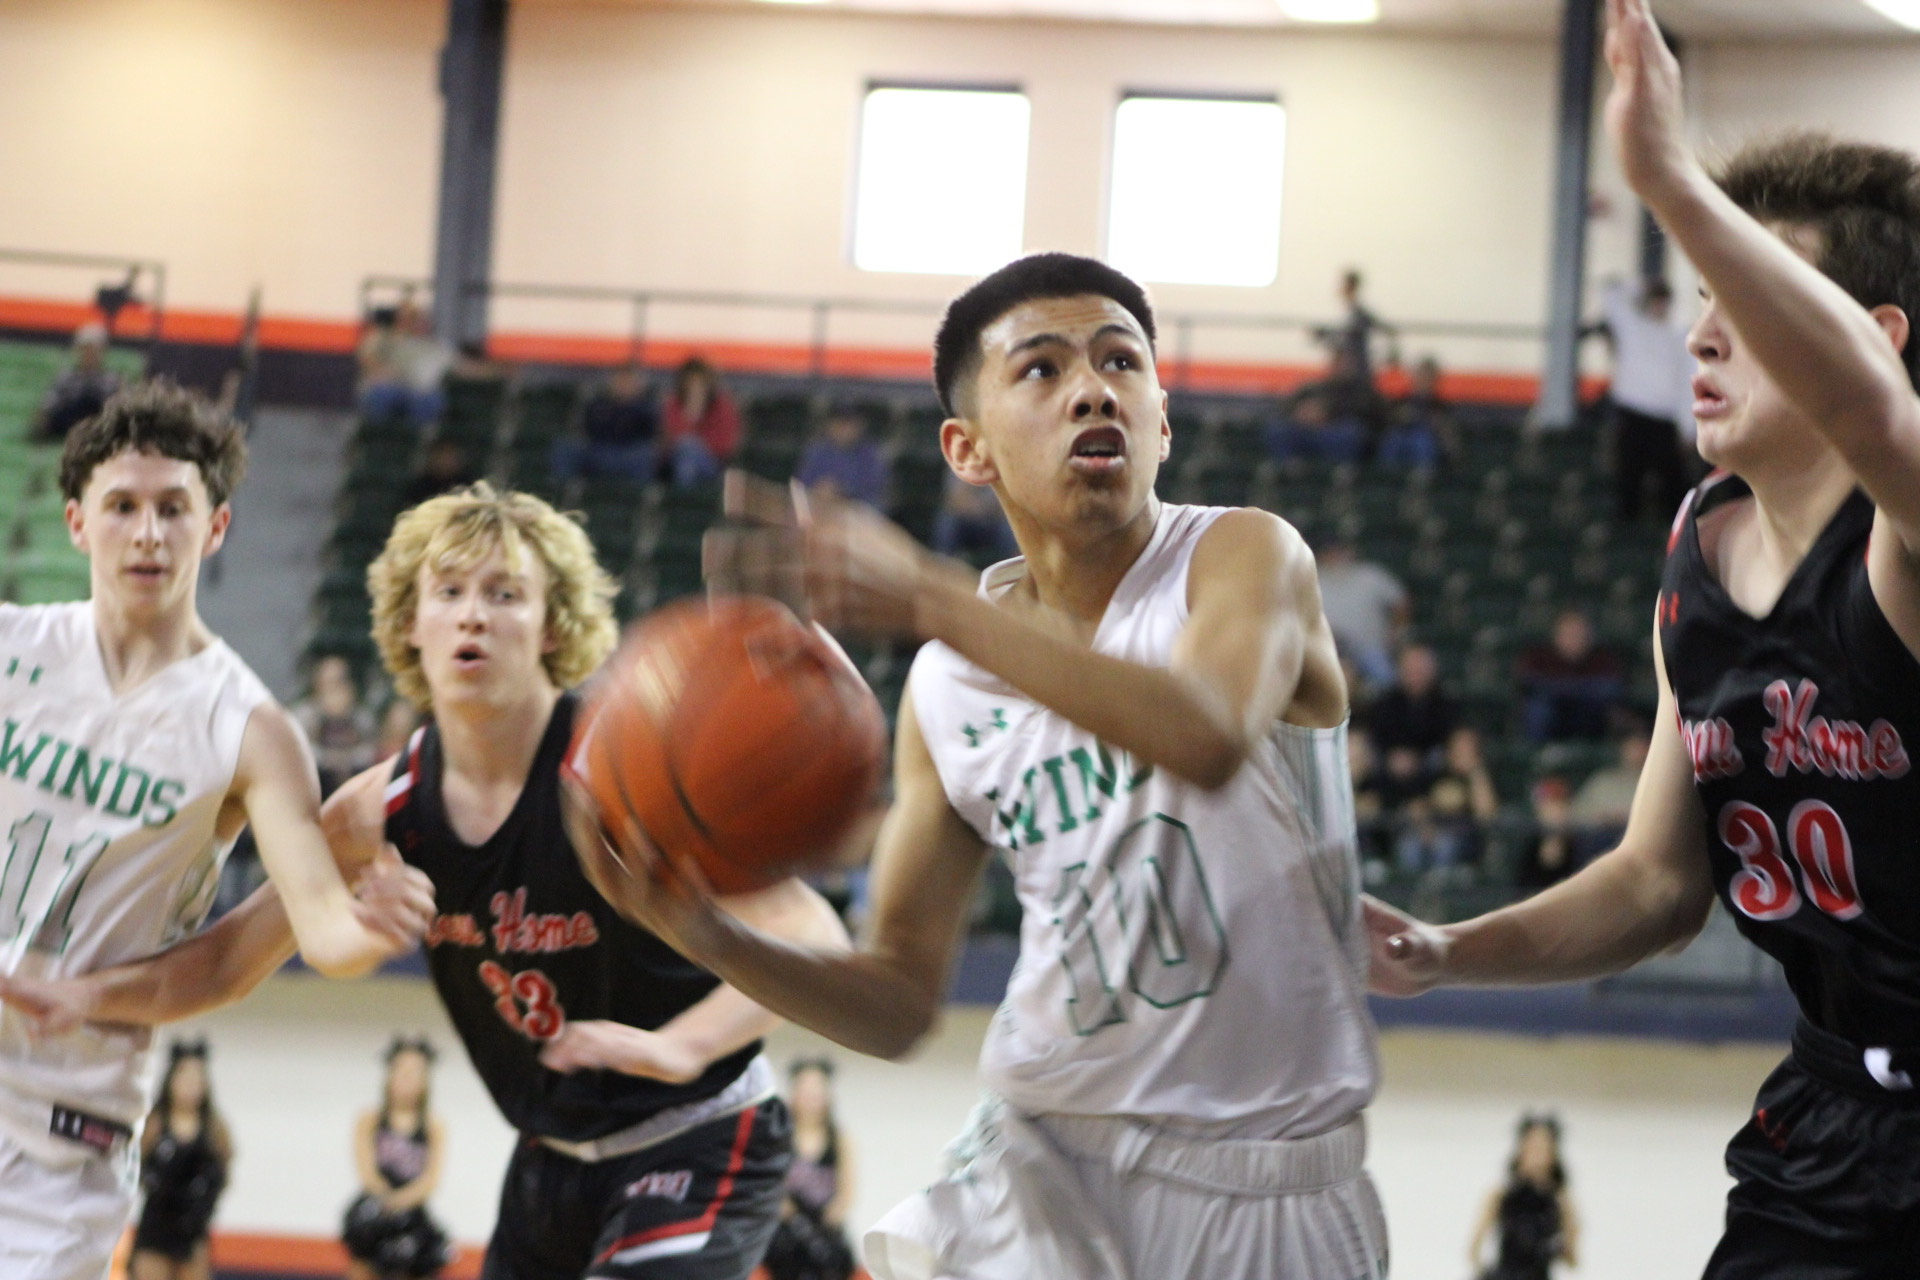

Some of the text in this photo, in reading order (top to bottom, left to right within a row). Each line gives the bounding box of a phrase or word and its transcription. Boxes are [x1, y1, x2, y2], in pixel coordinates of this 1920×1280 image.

[0, 717, 186, 828] WINDS
[1762, 678, 1912, 781] Home
[0, 810, 111, 955] 11
[1717, 799, 1863, 921] 30
[490, 885, 599, 953] Home
[1051, 811, 1231, 1036] 10
